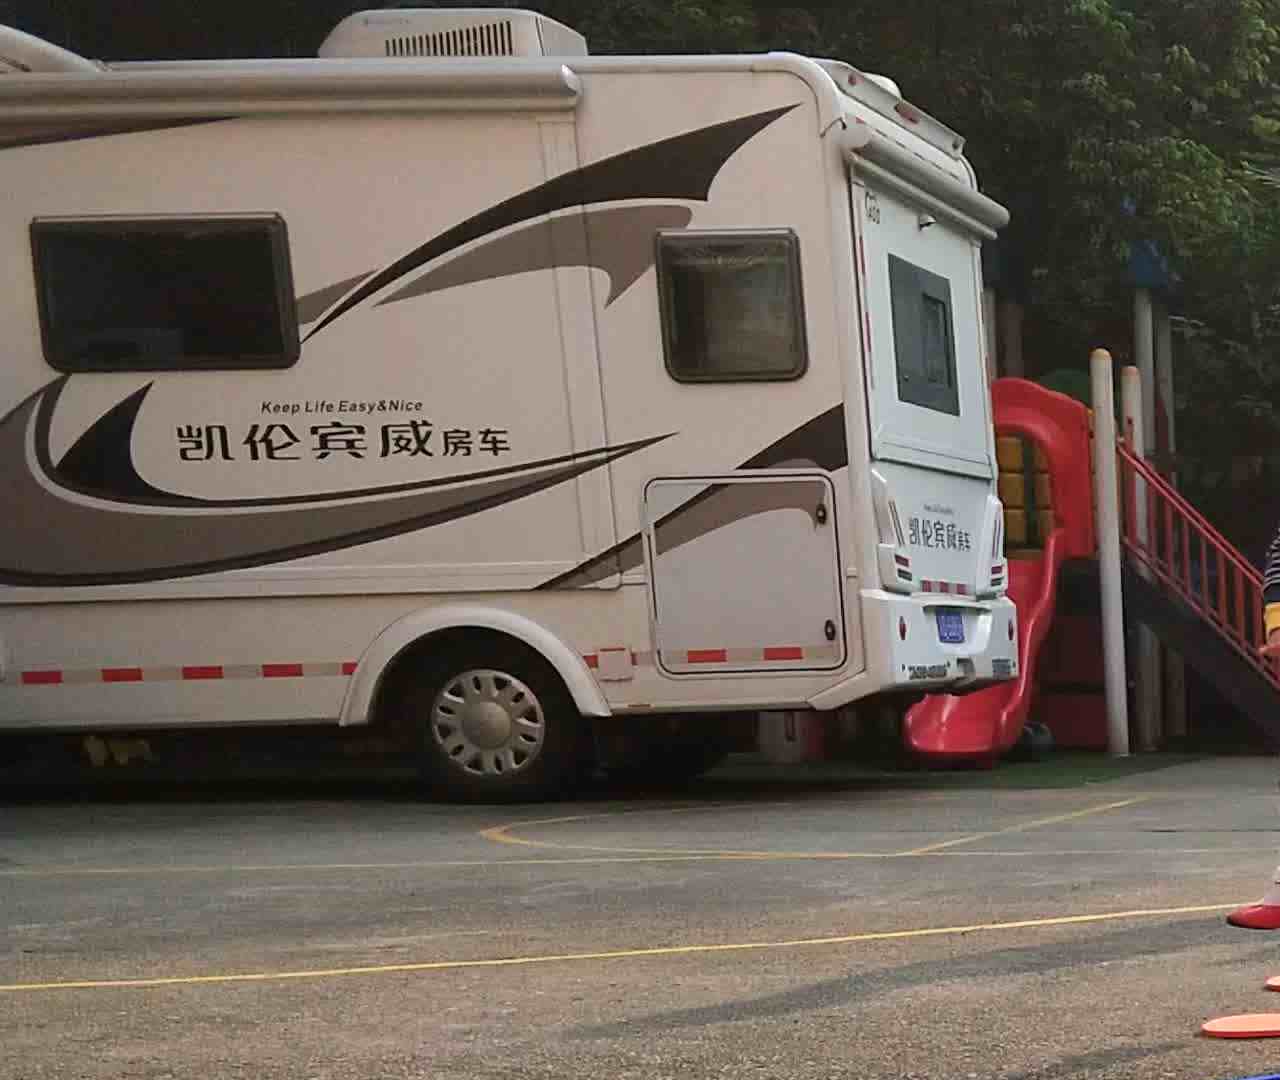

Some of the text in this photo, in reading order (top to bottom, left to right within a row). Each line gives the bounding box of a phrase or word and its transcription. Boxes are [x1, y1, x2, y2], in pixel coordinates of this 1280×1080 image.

[261, 399, 423, 415] Keep Life Easy&Nice
[176, 420, 511, 462] 凯伦宾威房车
